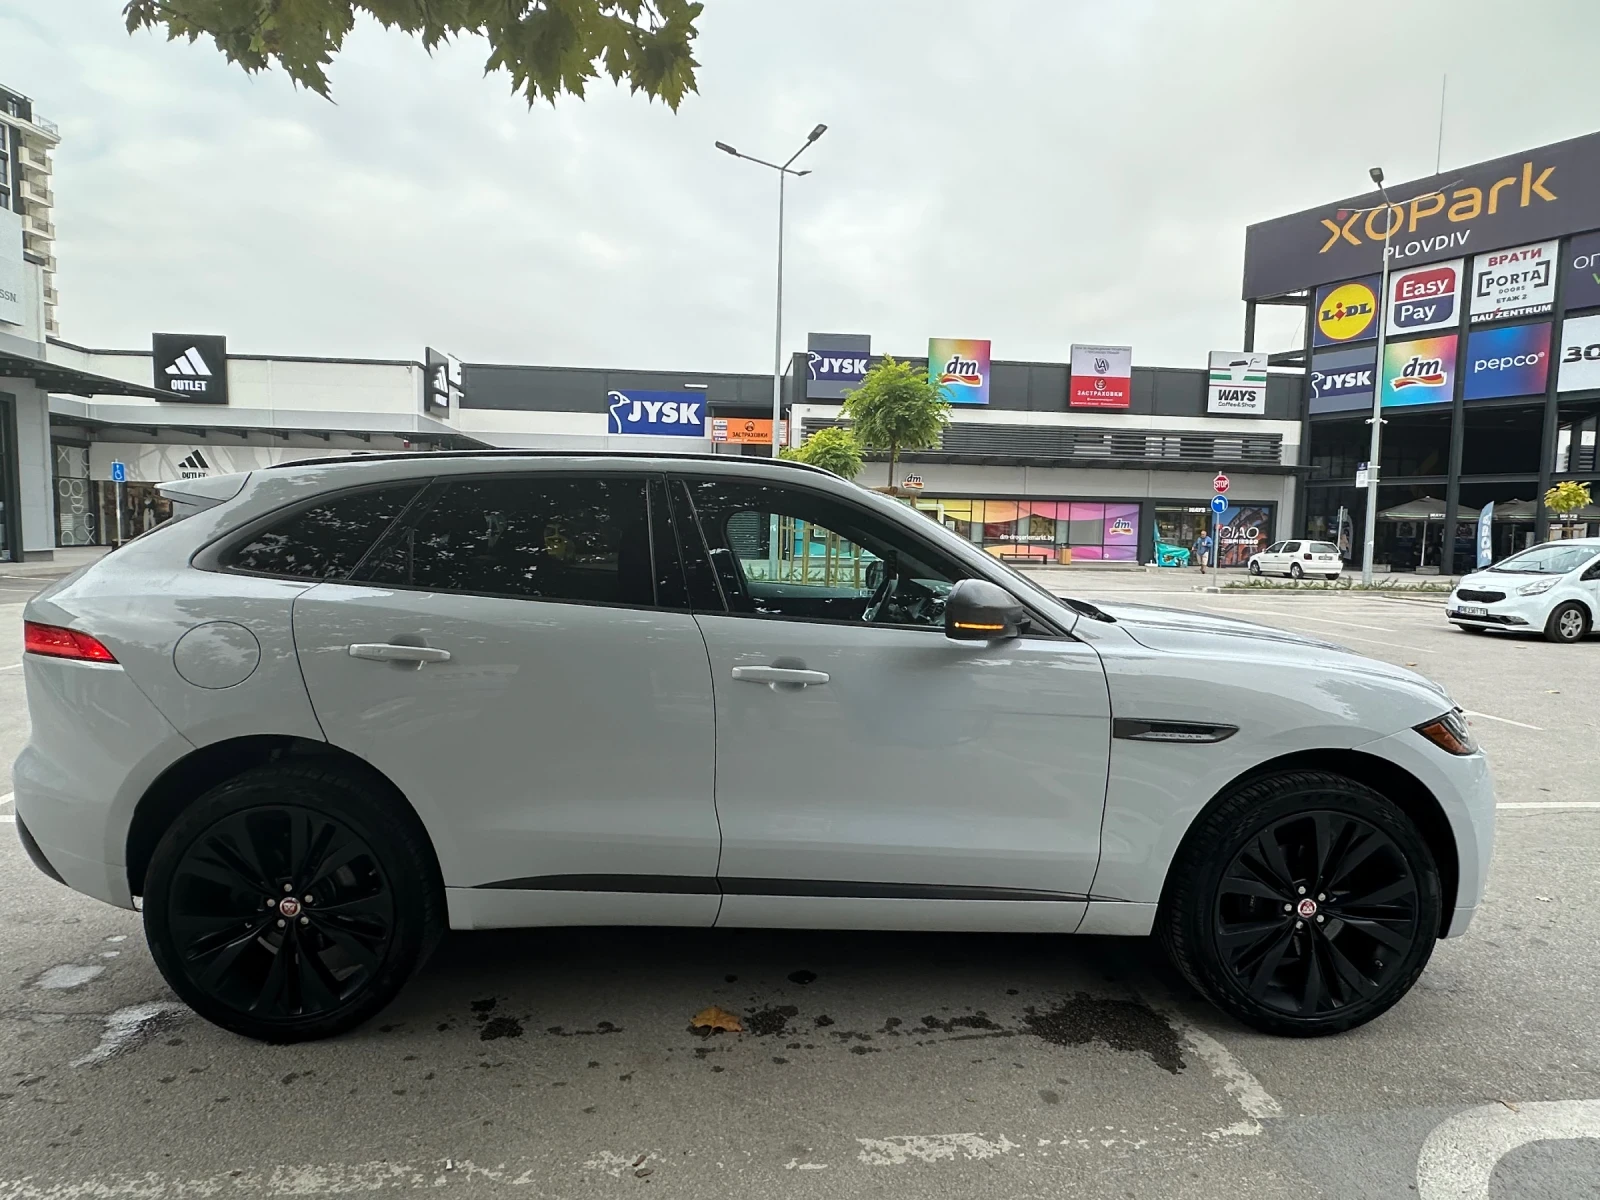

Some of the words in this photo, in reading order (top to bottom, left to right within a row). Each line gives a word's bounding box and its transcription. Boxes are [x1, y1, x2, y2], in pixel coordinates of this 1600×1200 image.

[1383, 230, 1471, 261] PLOVDIV
[1488, 248, 1542, 267] ВРАТИ
[1485, 269, 1542, 289] PORTA
[1402, 278, 1449, 298] Easy
[1498, 285, 1526, 295] DOORS
[1400, 304, 1437, 322] Pay
[820, 357, 868, 374] JYSK
[946, 356, 977, 375] dm
[1403, 357, 1440, 378] dm
[171, 379, 207, 391] OUTLET
[1322, 370, 1372, 390] JYSK
[1077, 389, 1123, 397] ЗАСТРАХОВКИ
[1218, 389, 1257, 402] WAYS
[627, 400, 701, 425] JYSK
[906, 473, 922, 483] dm
[1215, 480, 1229, 488] STOP
[1113, 519, 1131, 529] dm
[1220, 526, 1260, 539] CIAO
